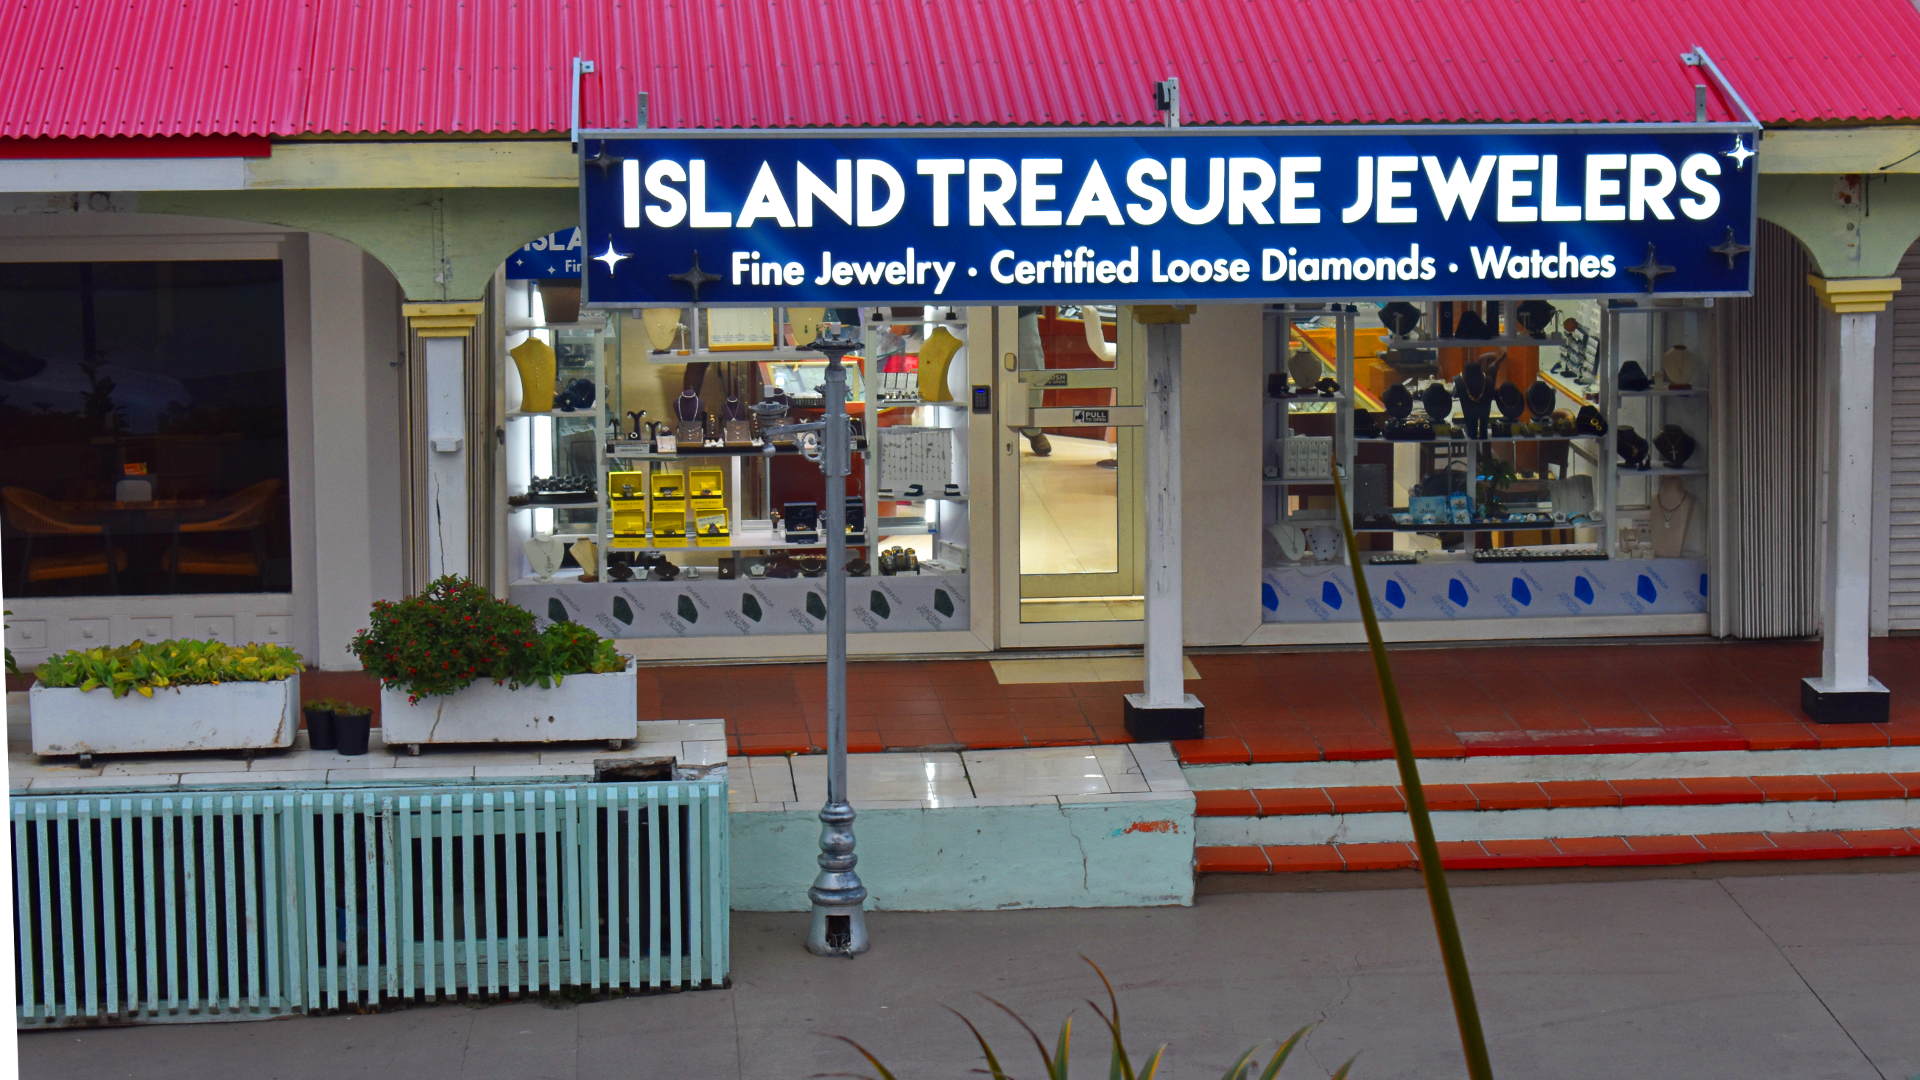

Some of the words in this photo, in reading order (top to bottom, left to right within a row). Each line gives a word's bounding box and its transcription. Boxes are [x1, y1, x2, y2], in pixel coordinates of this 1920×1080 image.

[622, 159, 906, 229] ISLAND
[916, 156, 1322, 228] TREASURE
[1342, 153, 1722, 224] JEWELERS
[731, 250, 805, 286] Fine
[814, 247, 956, 295] Jewelry
[990, 245, 1139, 285] Certified
[1151, 249, 1251, 283] Loose
[1262, 243, 1437, 282] Diamonds
[1470, 241, 1617, 280] Watches
